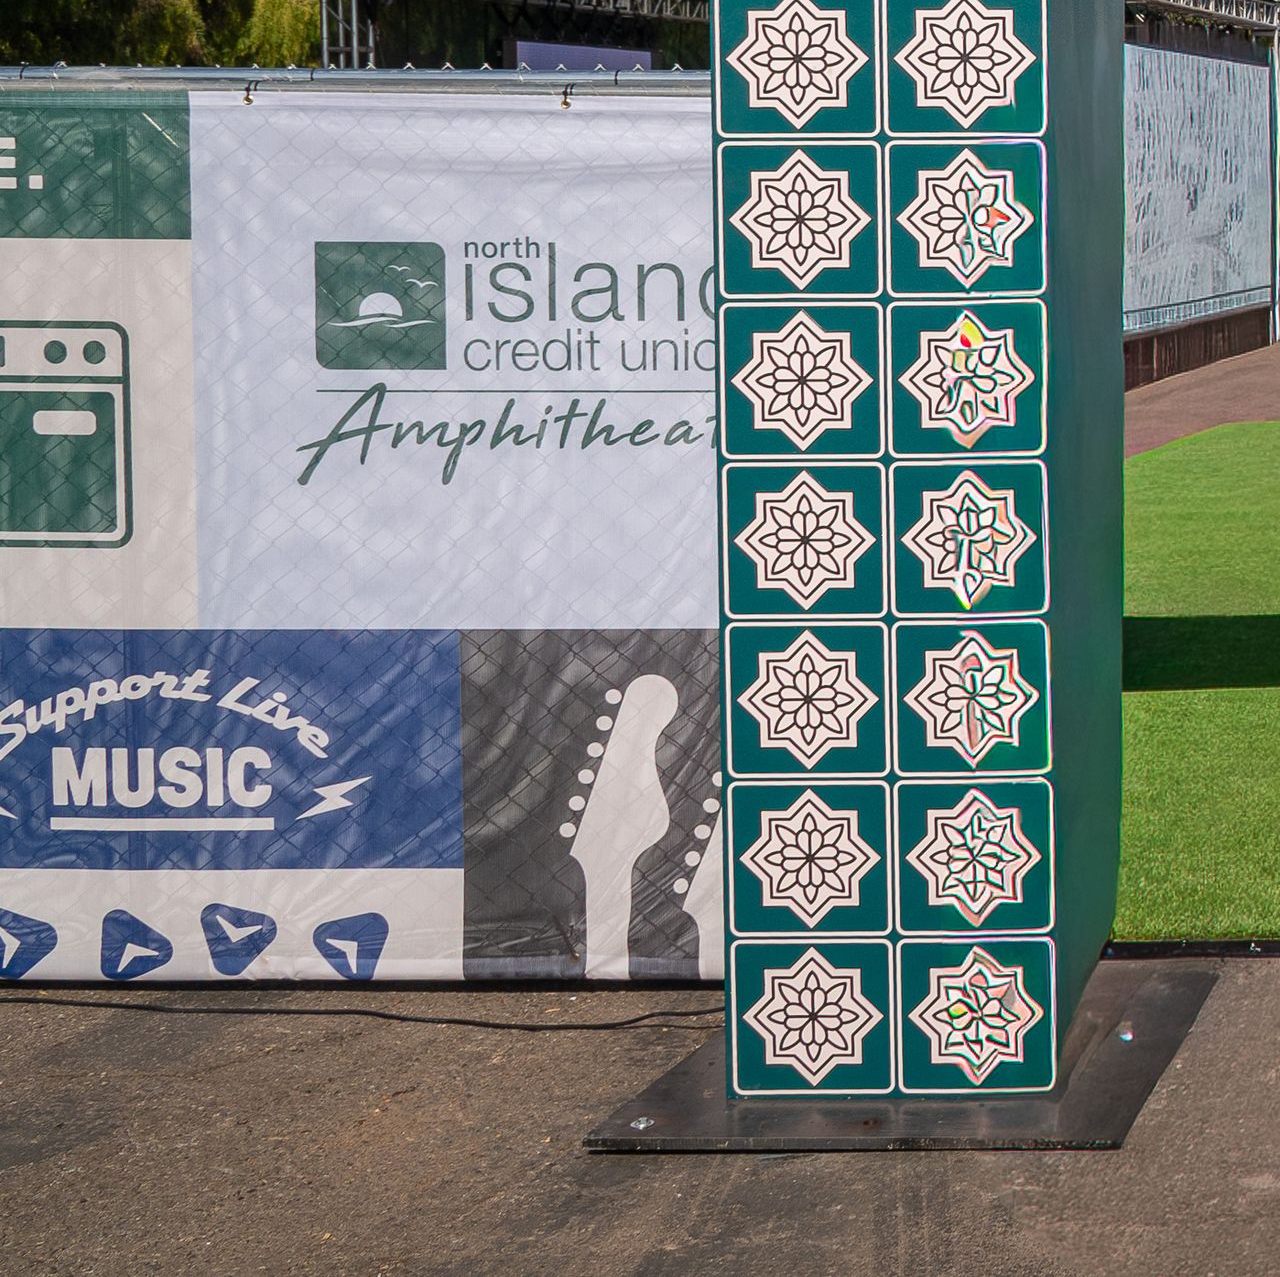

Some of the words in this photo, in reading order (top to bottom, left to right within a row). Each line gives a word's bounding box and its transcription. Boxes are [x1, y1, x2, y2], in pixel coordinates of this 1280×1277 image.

[464, 237, 541, 258] north
[464, 329, 600, 371] credit
[621, 328, 716, 371] unio
[0, 669, 212, 761] Support
[216, 676, 329, 758] Live
[52, 746, 272, 808] MUSIC
